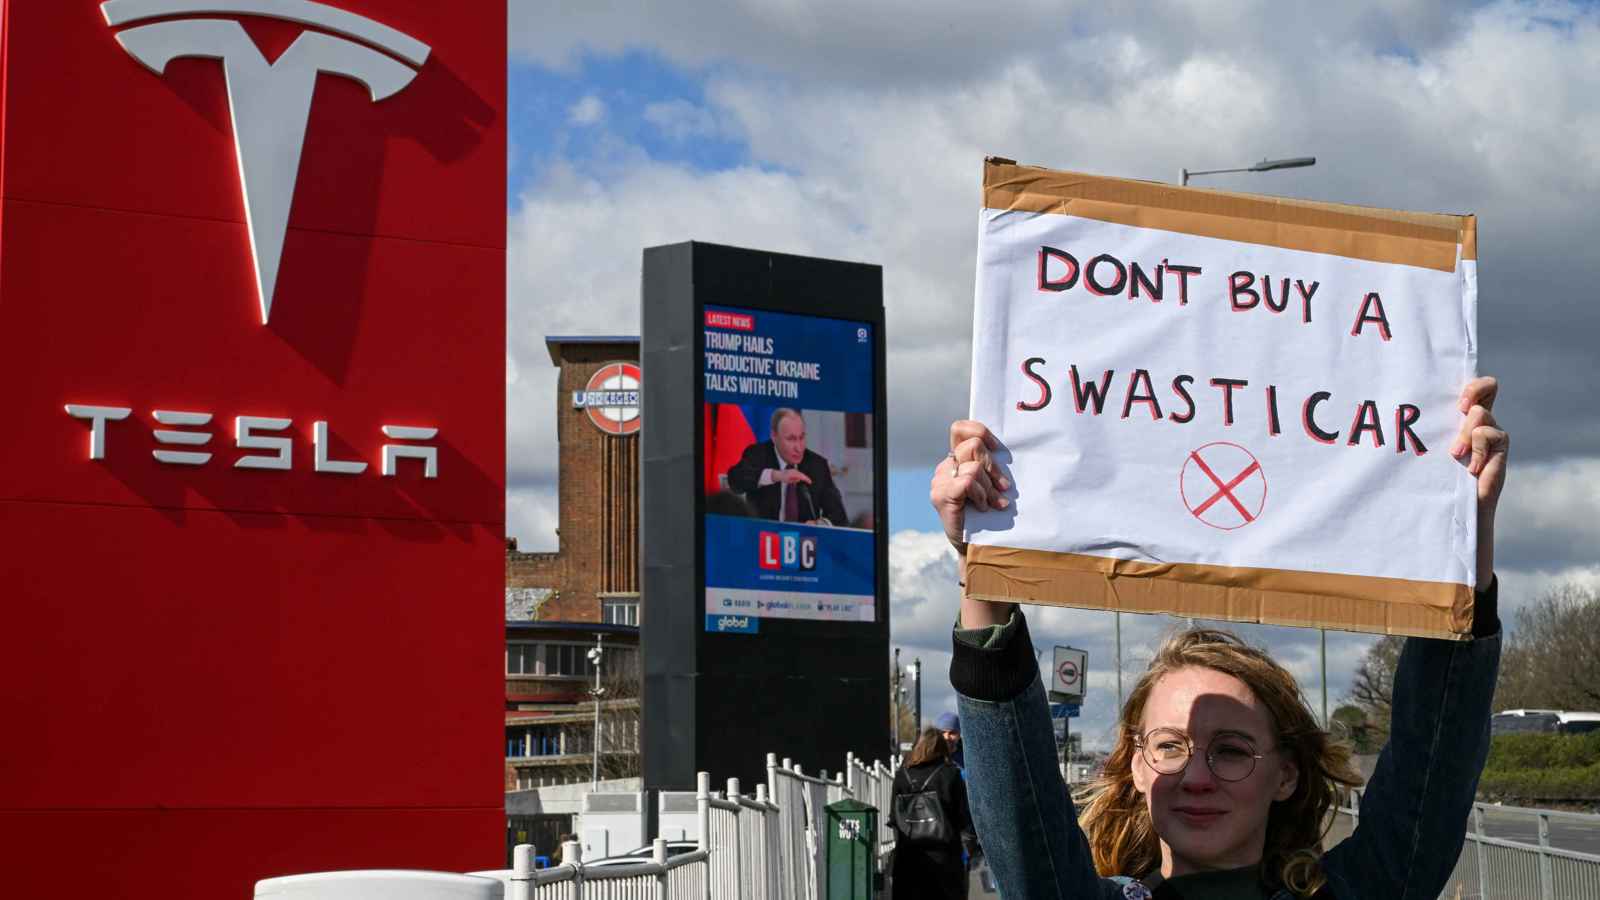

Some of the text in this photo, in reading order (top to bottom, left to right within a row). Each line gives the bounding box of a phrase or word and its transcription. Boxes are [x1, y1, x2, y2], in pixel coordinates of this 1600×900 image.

[1038, 246, 1392, 341] DON'T BUY A
[708, 313, 751, 328] LATEST NEWS
[704, 331, 773, 355] TRUMP HAILS
[705, 352, 820, 380] 'PRODUCTIVE' UKRAINE
[704, 373, 798, 399] TALKS WITH PUTIN
[1017, 357, 1429, 457] SWASTICAR
[64, 404, 439, 478] TESLA
[765, 535, 815, 569] LBC
[718, 615, 748, 631] global
